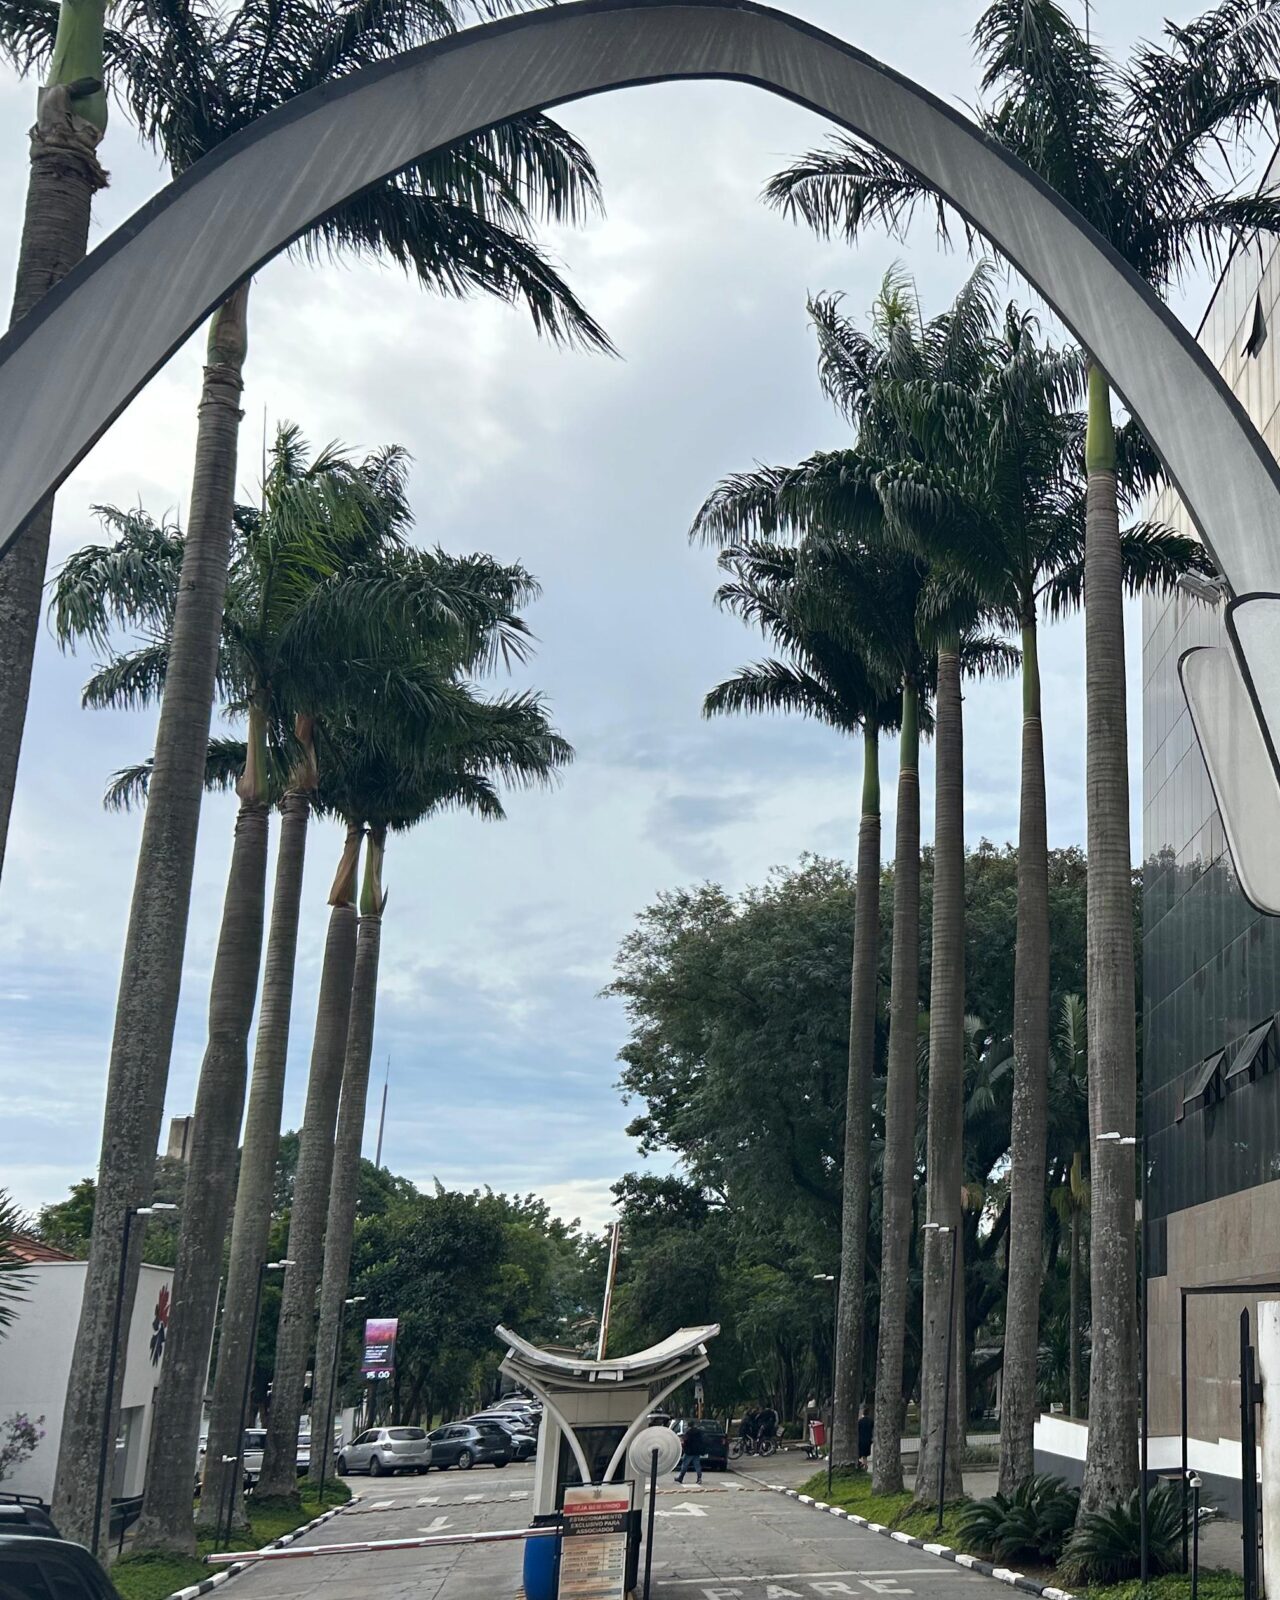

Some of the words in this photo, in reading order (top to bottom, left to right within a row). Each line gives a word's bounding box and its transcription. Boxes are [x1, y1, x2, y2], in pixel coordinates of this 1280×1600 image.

[569, 1513, 623, 1522] ESTACIONAMENTO
[570, 1521, 604, 1529] EXCLUSIVO
[575, 1526, 615, 1535] ASSOCIADOS
[701, 1578, 915, 1600] PARE
